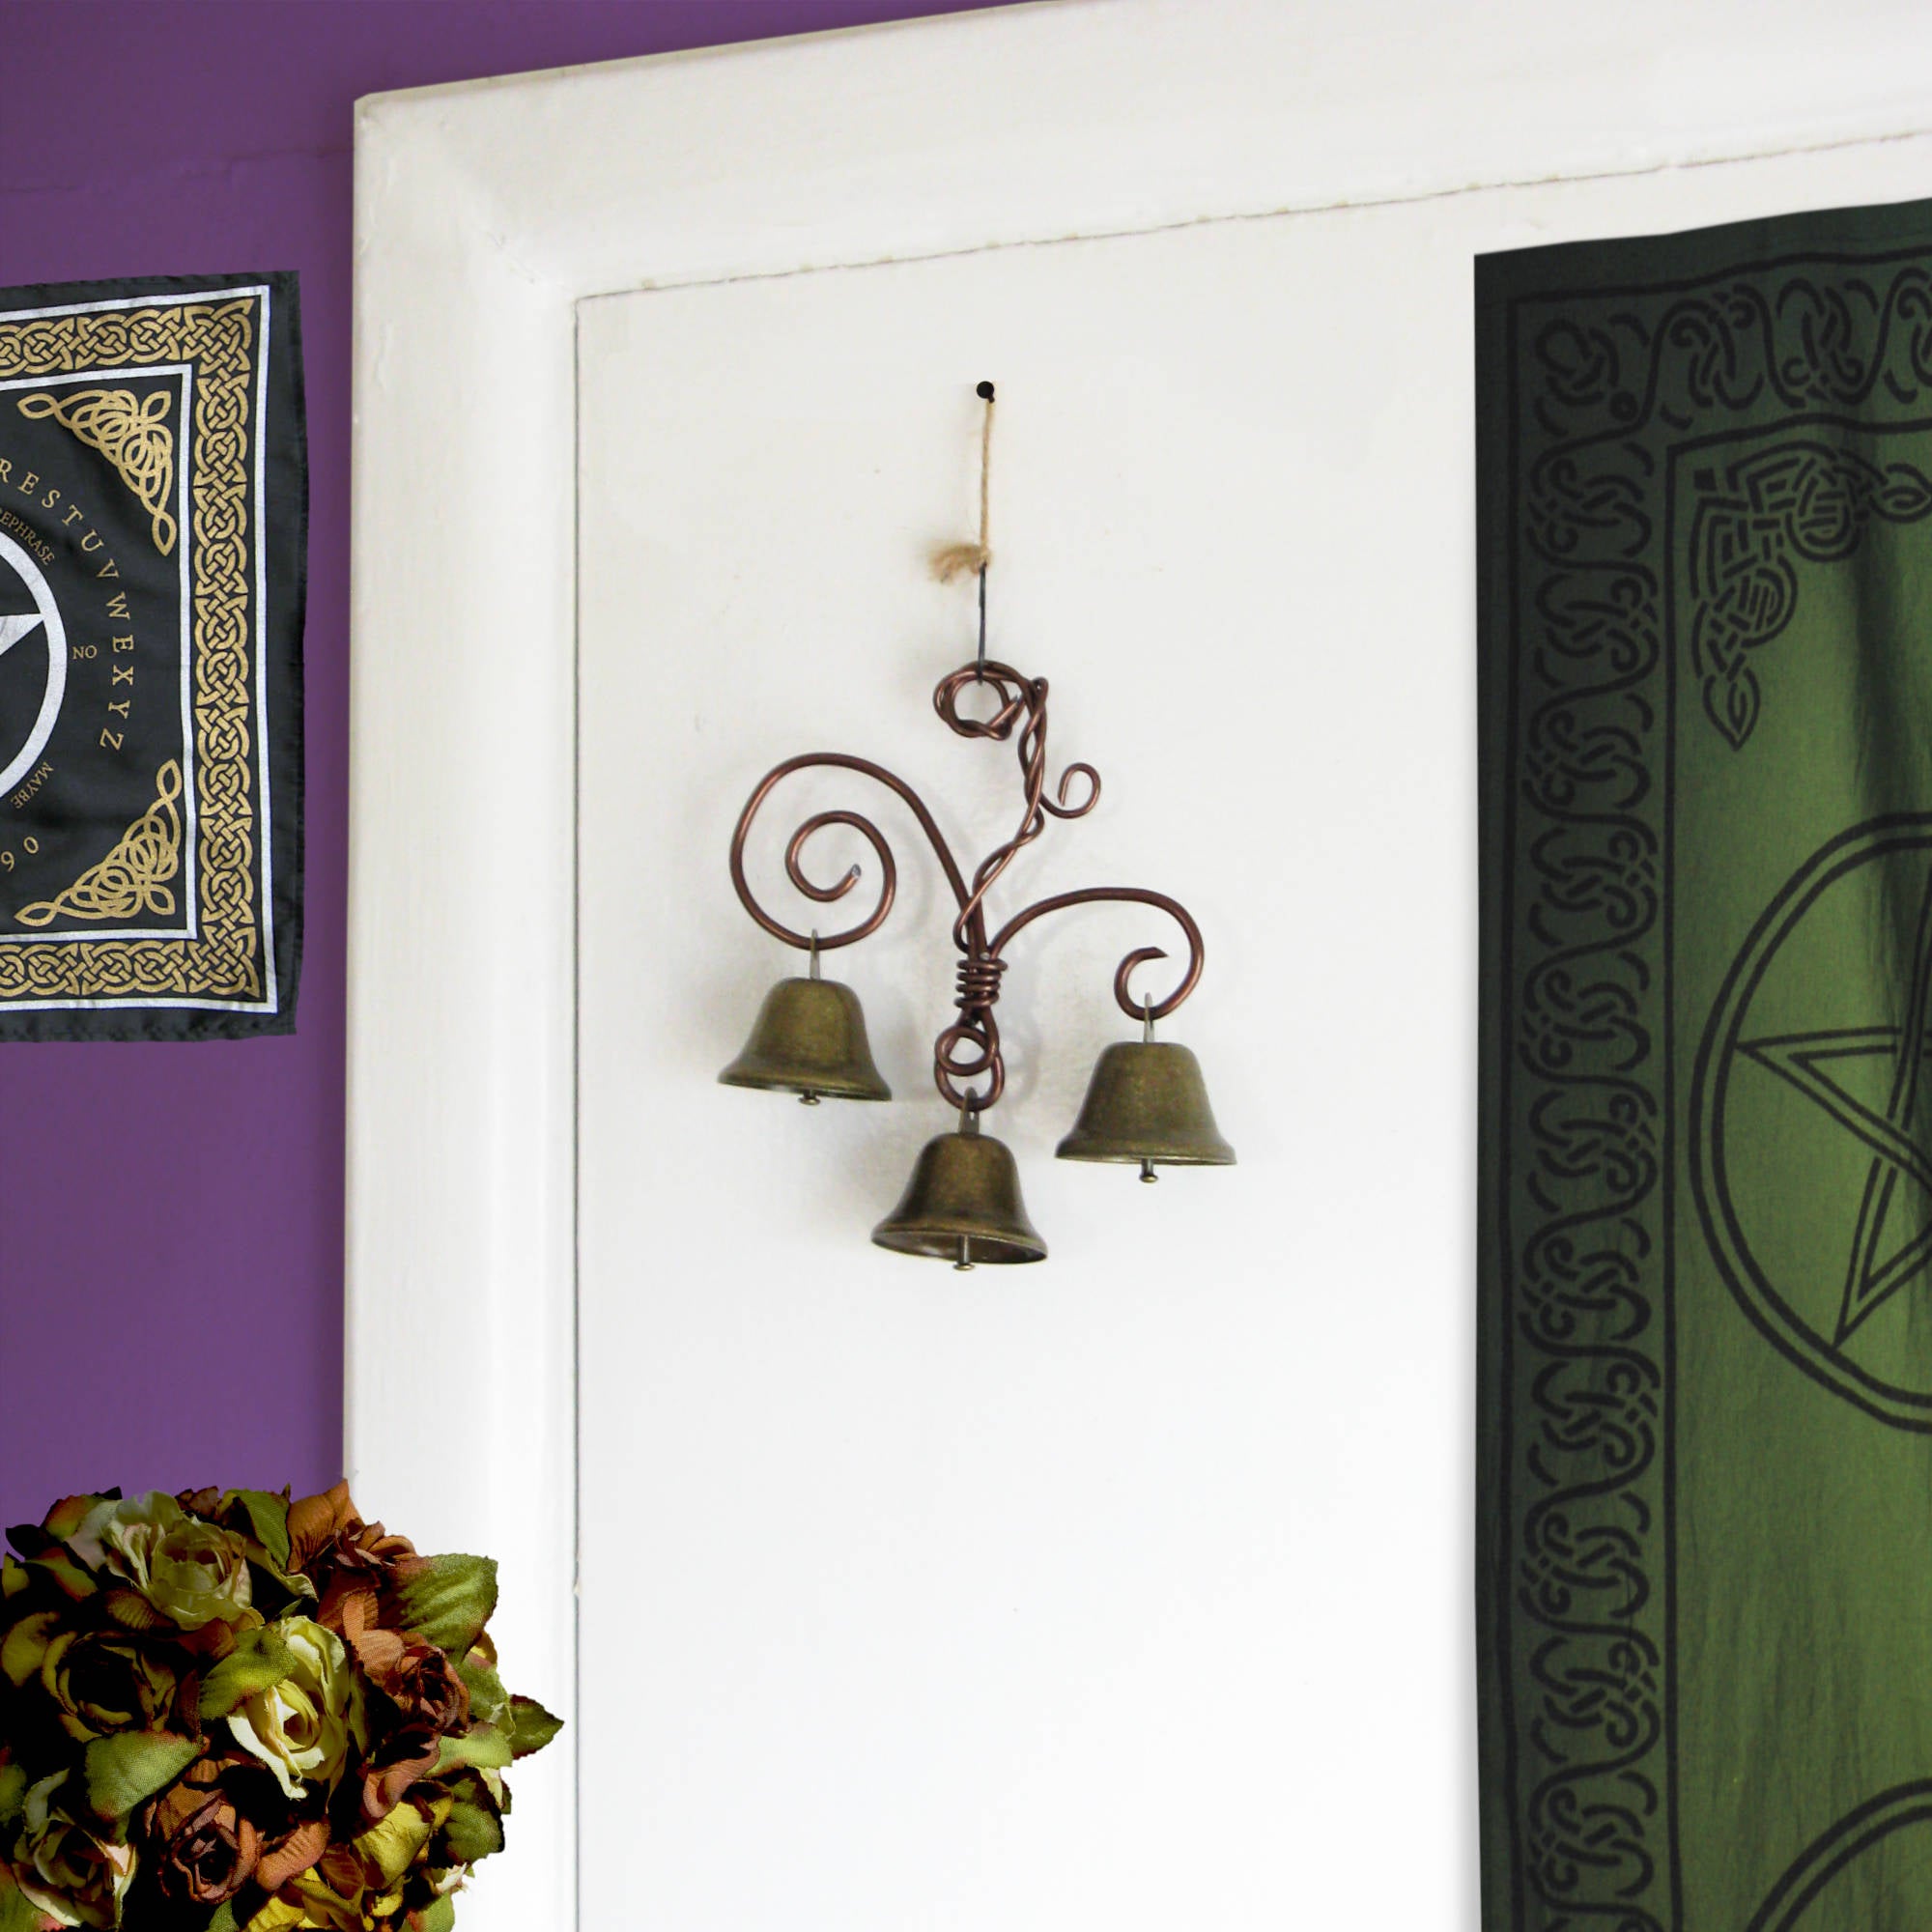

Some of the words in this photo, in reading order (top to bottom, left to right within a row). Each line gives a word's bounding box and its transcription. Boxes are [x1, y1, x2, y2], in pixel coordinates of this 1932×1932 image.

[0, 507, 55, 566] EPHRASE
[71, 644, 98, 660] NO
[10, 761, 54, 809] MAYBE
